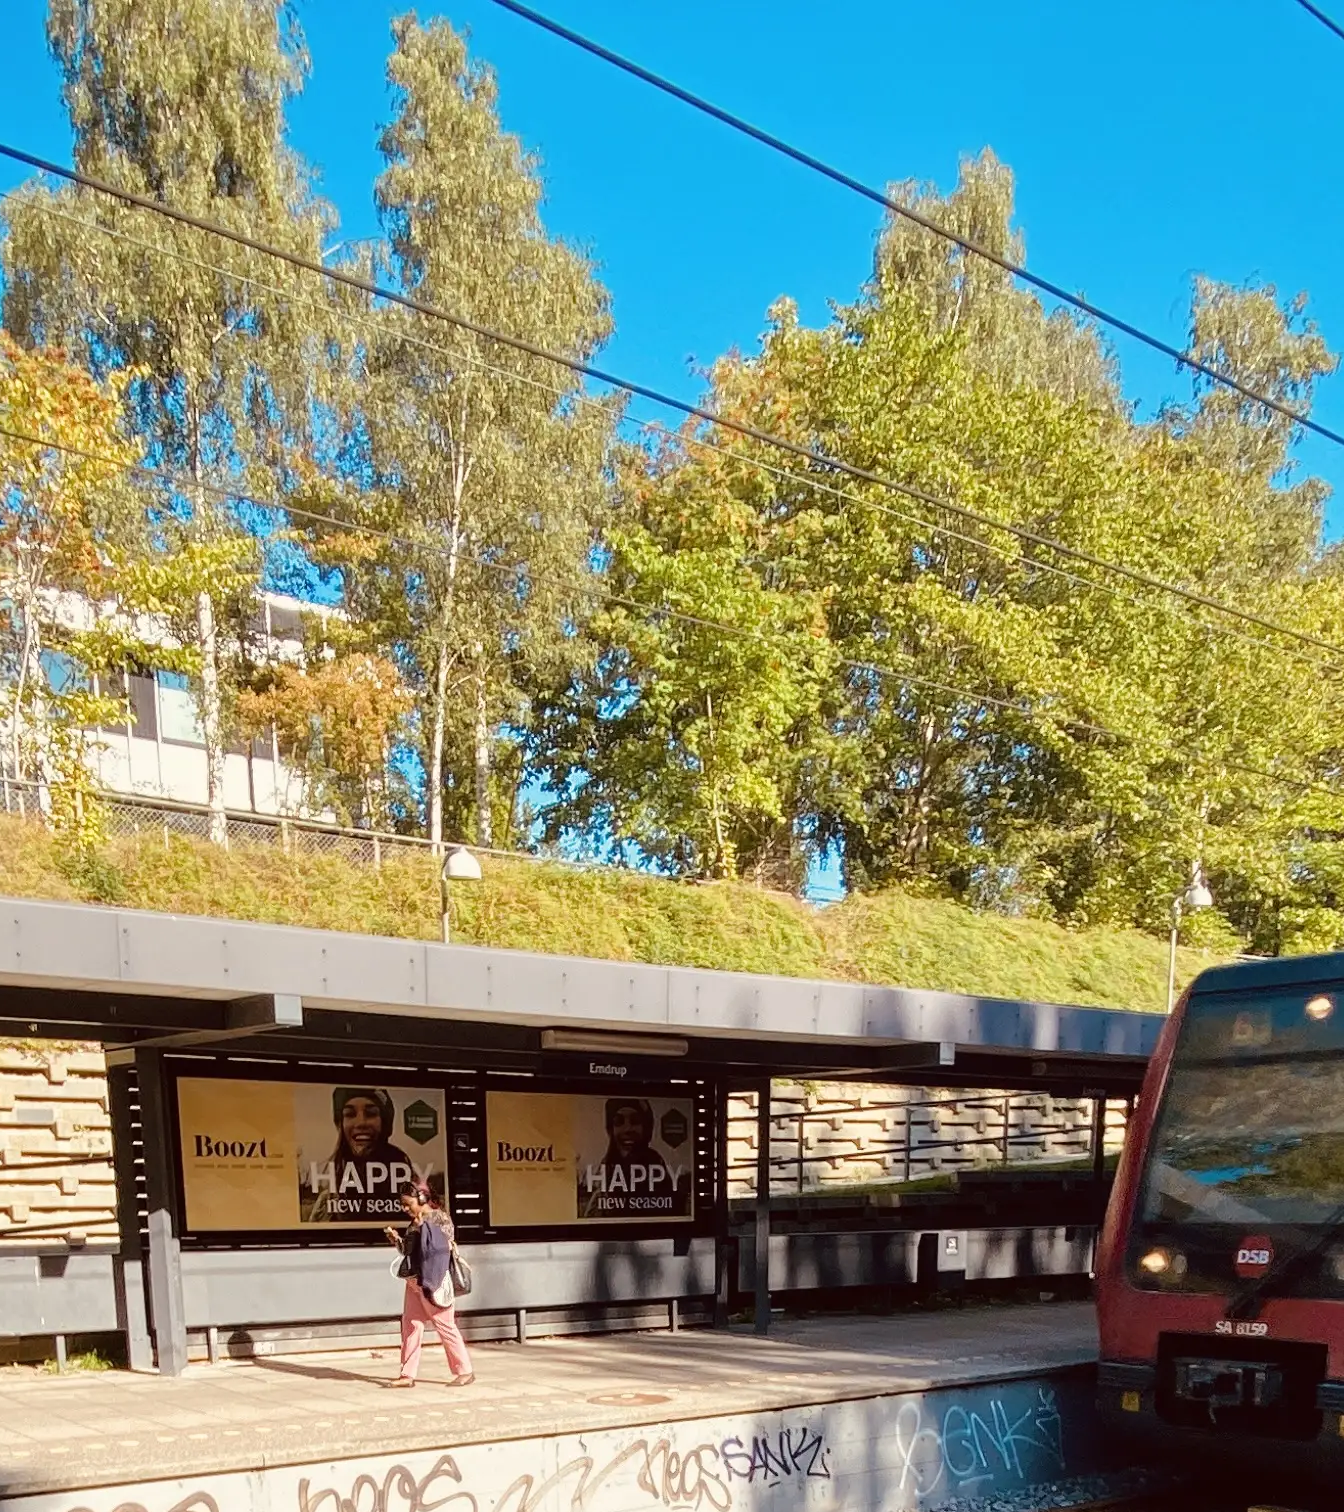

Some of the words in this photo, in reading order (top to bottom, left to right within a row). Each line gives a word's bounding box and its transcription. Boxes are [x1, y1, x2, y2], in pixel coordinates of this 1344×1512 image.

[589, 1062, 627, 1077] Emdrup
[194, 1134, 267, 1158] Boozt
[497, 1141, 555, 1162] Boozt
[587, 1163, 684, 1193] HAPPY
[326, 1197, 363, 1213] new
[598, 1196, 626, 1209] new
[629, 1196, 673, 1209] season
[1237, 1250, 1270, 1264] DSB
[1215, 1321, 1232, 1333] SA
